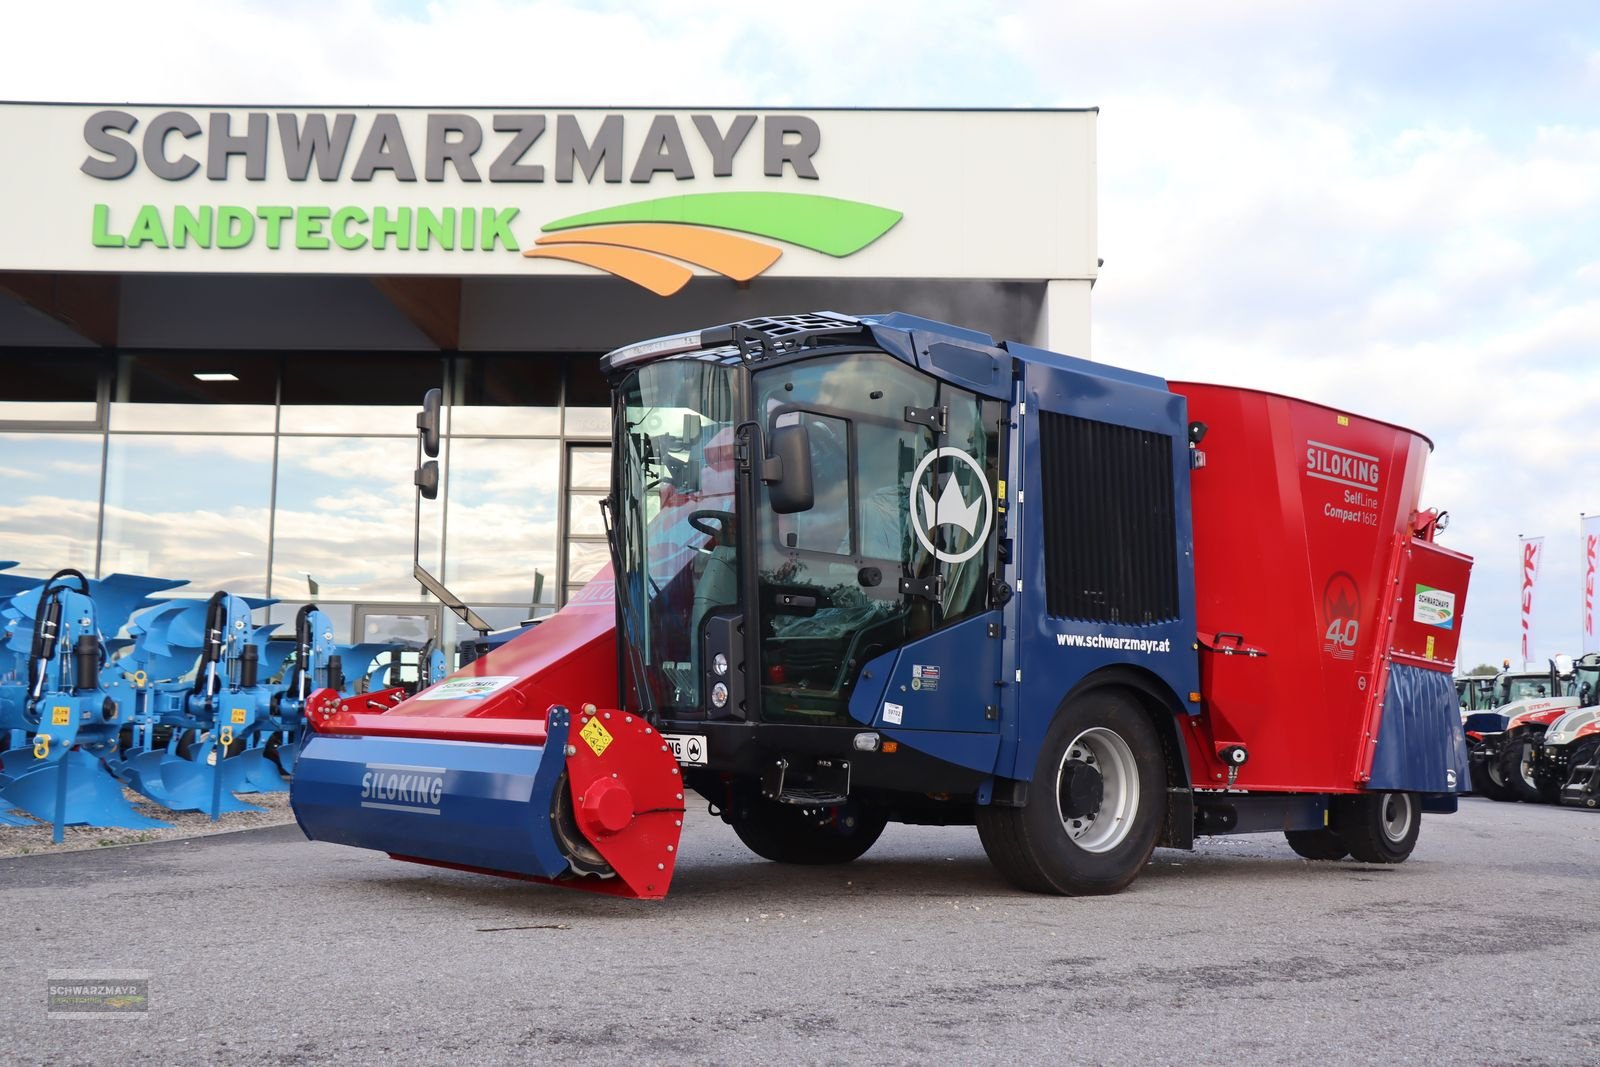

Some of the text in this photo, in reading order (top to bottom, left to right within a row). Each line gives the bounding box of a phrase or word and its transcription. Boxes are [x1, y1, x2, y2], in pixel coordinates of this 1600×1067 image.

[80, 110, 821, 184] SCHWARZMAYR
[92, 204, 520, 251] LANDTECHNIK
[1307, 448, 1379, 484] SILOKING
[1324, 502, 1377, 526] Compact 1612
[1344, 489, 1378, 509] SelfLine
[1057, 634, 1170, 654] www.schwarzmayr.at
[361, 772, 443, 805] SILOKING
